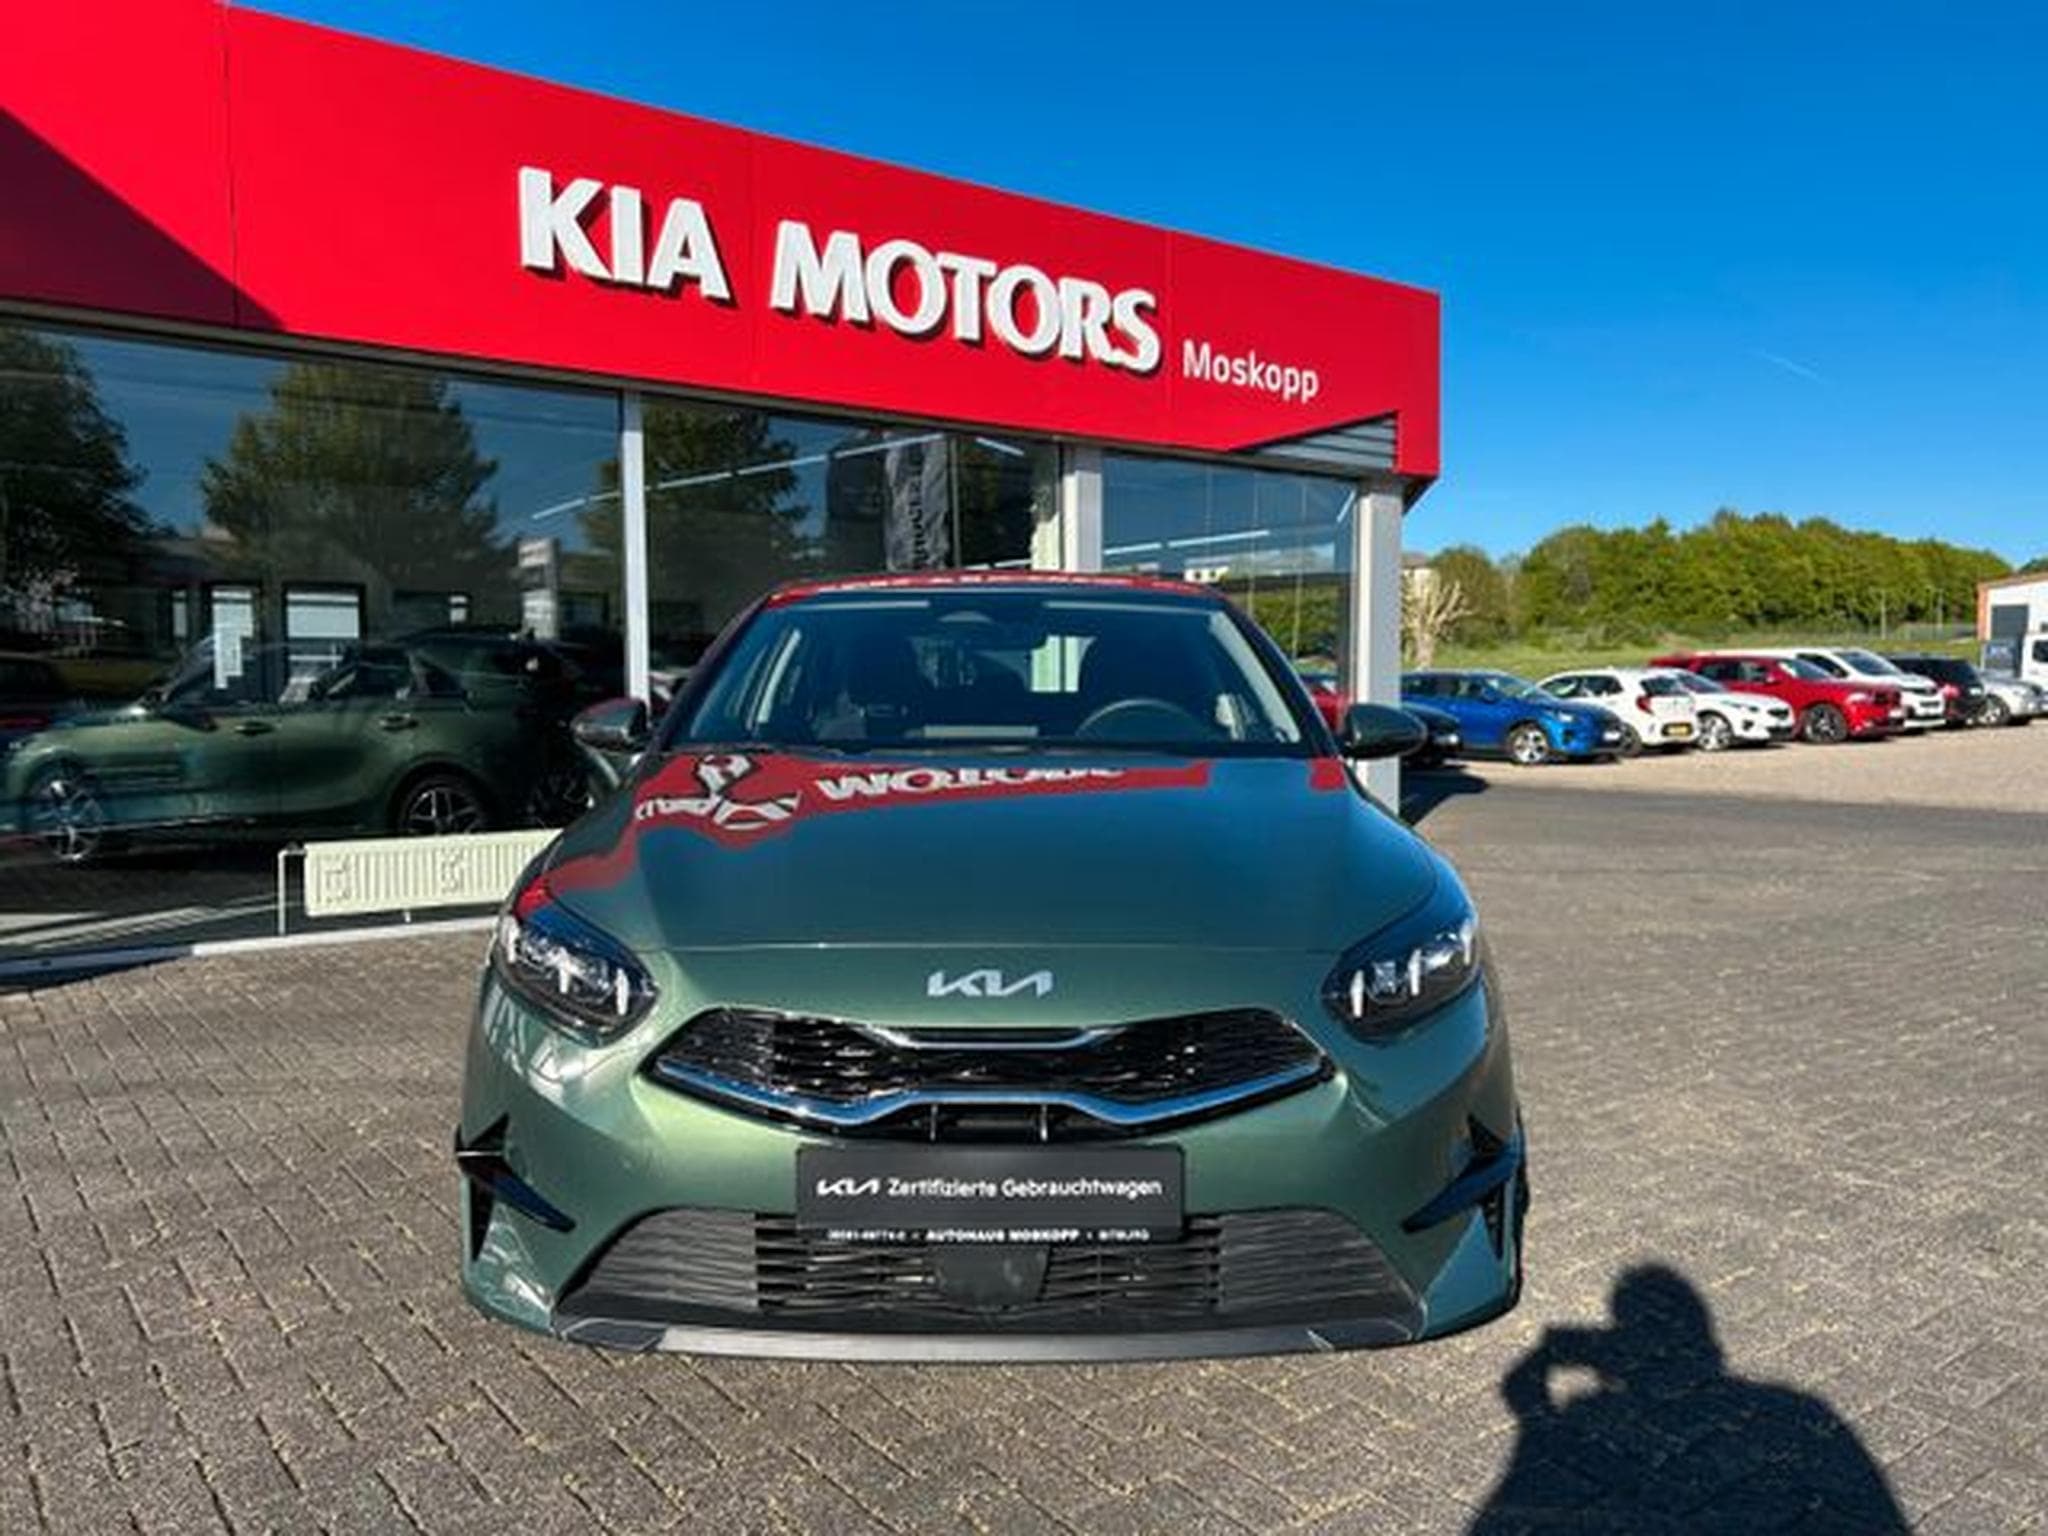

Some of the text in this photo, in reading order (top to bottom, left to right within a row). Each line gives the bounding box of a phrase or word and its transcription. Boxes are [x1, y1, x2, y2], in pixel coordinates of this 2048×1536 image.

[516, 165, 1162, 373] KIA MOTORS
[1183, 338, 1319, 404] Moskopp
[927, 969, 1053, 997] KIA
[816, 1176, 1163, 1200] KIA Zertifizierte Gebrauchtwagen
